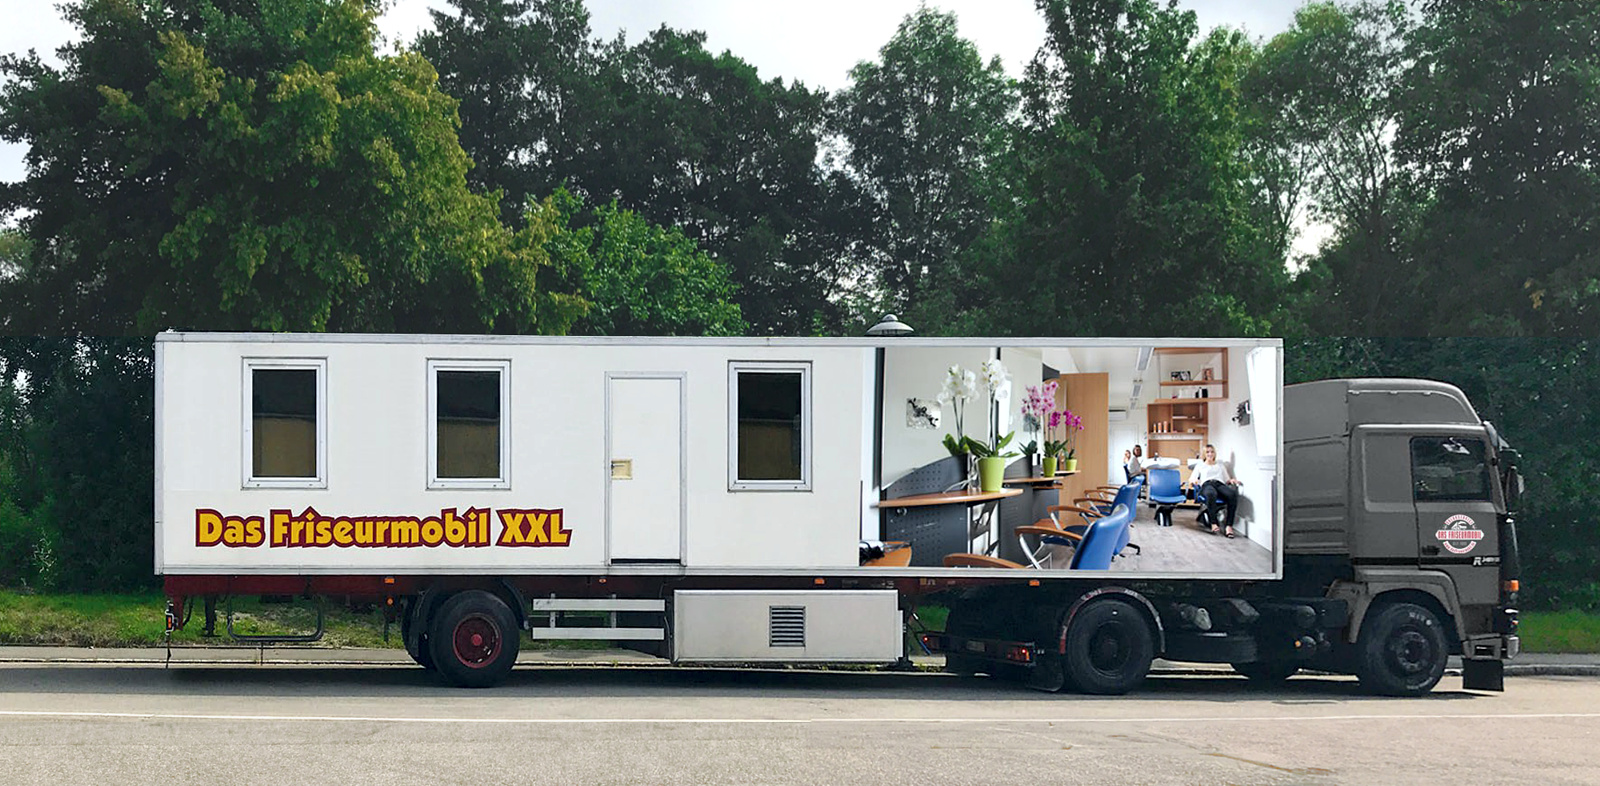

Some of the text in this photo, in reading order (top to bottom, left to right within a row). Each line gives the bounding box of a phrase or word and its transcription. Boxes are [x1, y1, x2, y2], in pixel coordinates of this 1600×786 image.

[196, 506, 573, 548] Das Friseurmobil XXL
